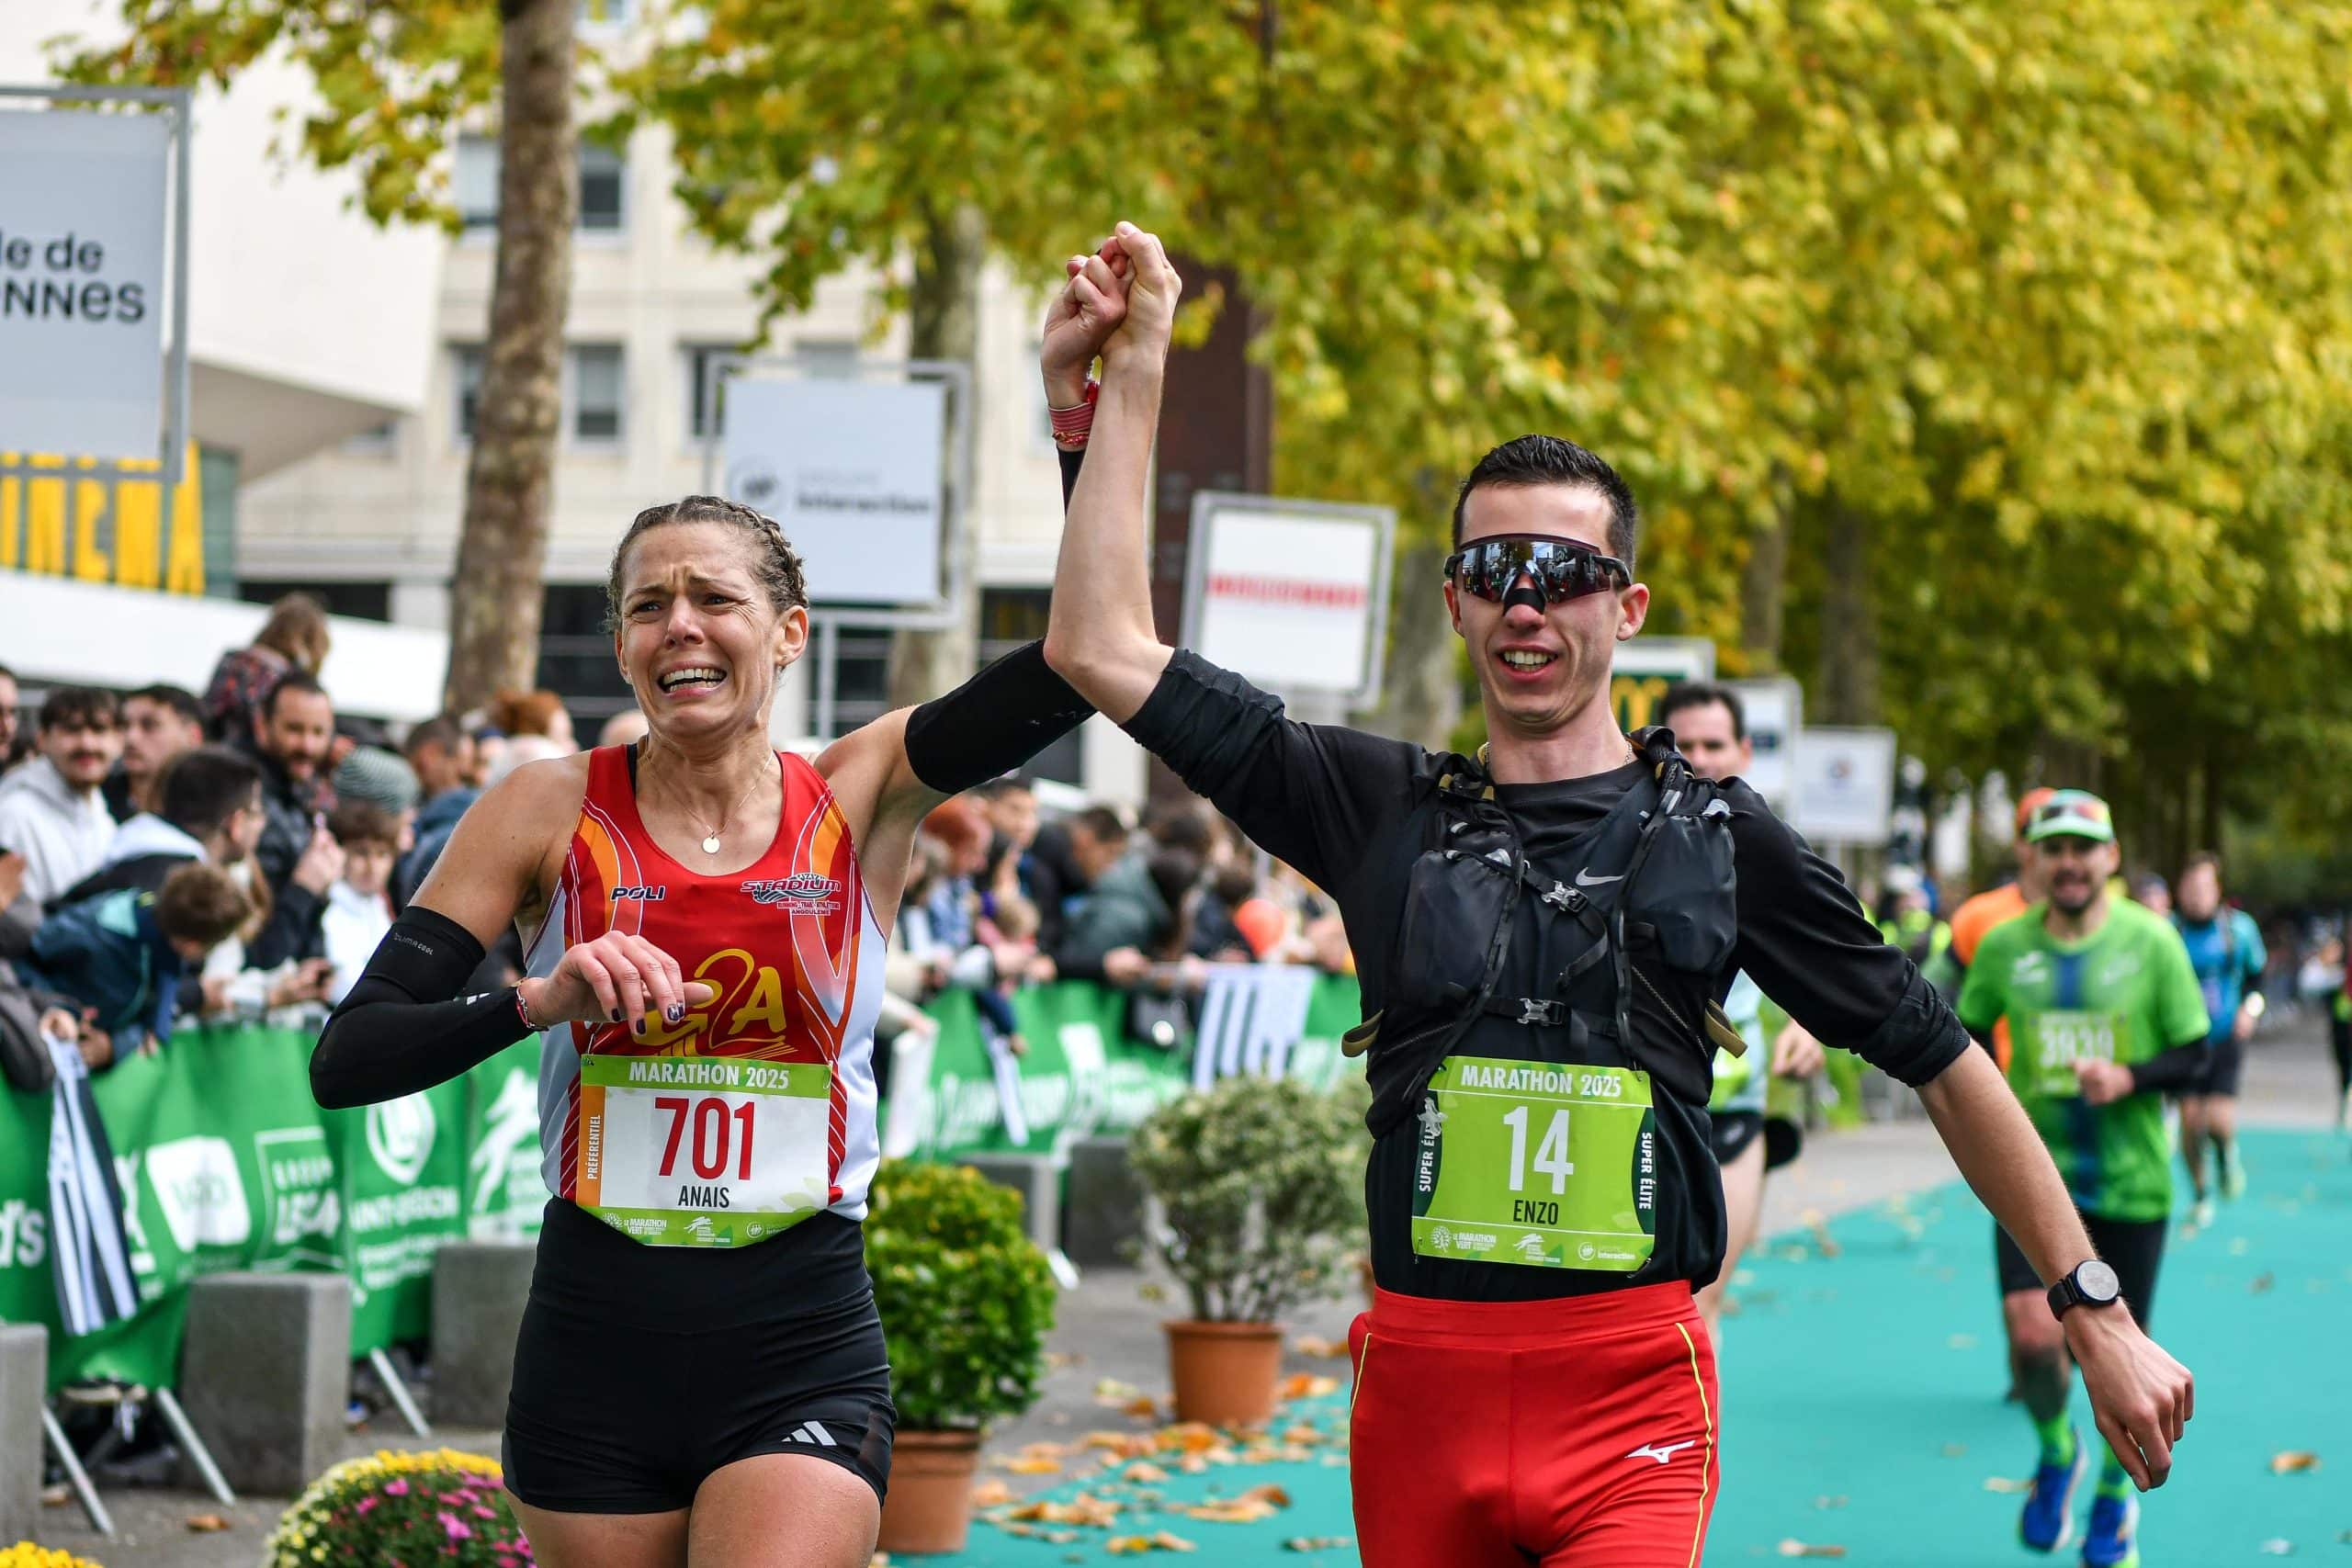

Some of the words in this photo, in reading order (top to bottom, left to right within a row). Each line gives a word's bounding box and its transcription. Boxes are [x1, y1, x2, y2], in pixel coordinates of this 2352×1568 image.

[45, 231, 104, 274] de
[611, 886, 665, 901] POLI
[741, 879, 842, 892] STADIUM
[628, 1062, 740, 1086] MARATHON
[746, 1066, 789, 1089] 2025
[1461, 1065, 1572, 1094] MARATHON
[1579, 1074, 1622, 1098] 2025
[587, 1115, 601, 1179] PRÉFÉRENTIEL
[654, 1097, 755, 1180] 701
[1503, 1105, 1574, 1195] 14
[1640, 1132, 1653, 1174] SUPER
[1419, 1151, 1433, 1192] SUPER
[677, 1185, 729, 1208] ANAIS
[1638, 1178, 1657, 1210] ÉLITE
[630, 1218, 667, 1228] MARATHON
[1513, 1199, 1559, 1225] ENZO
